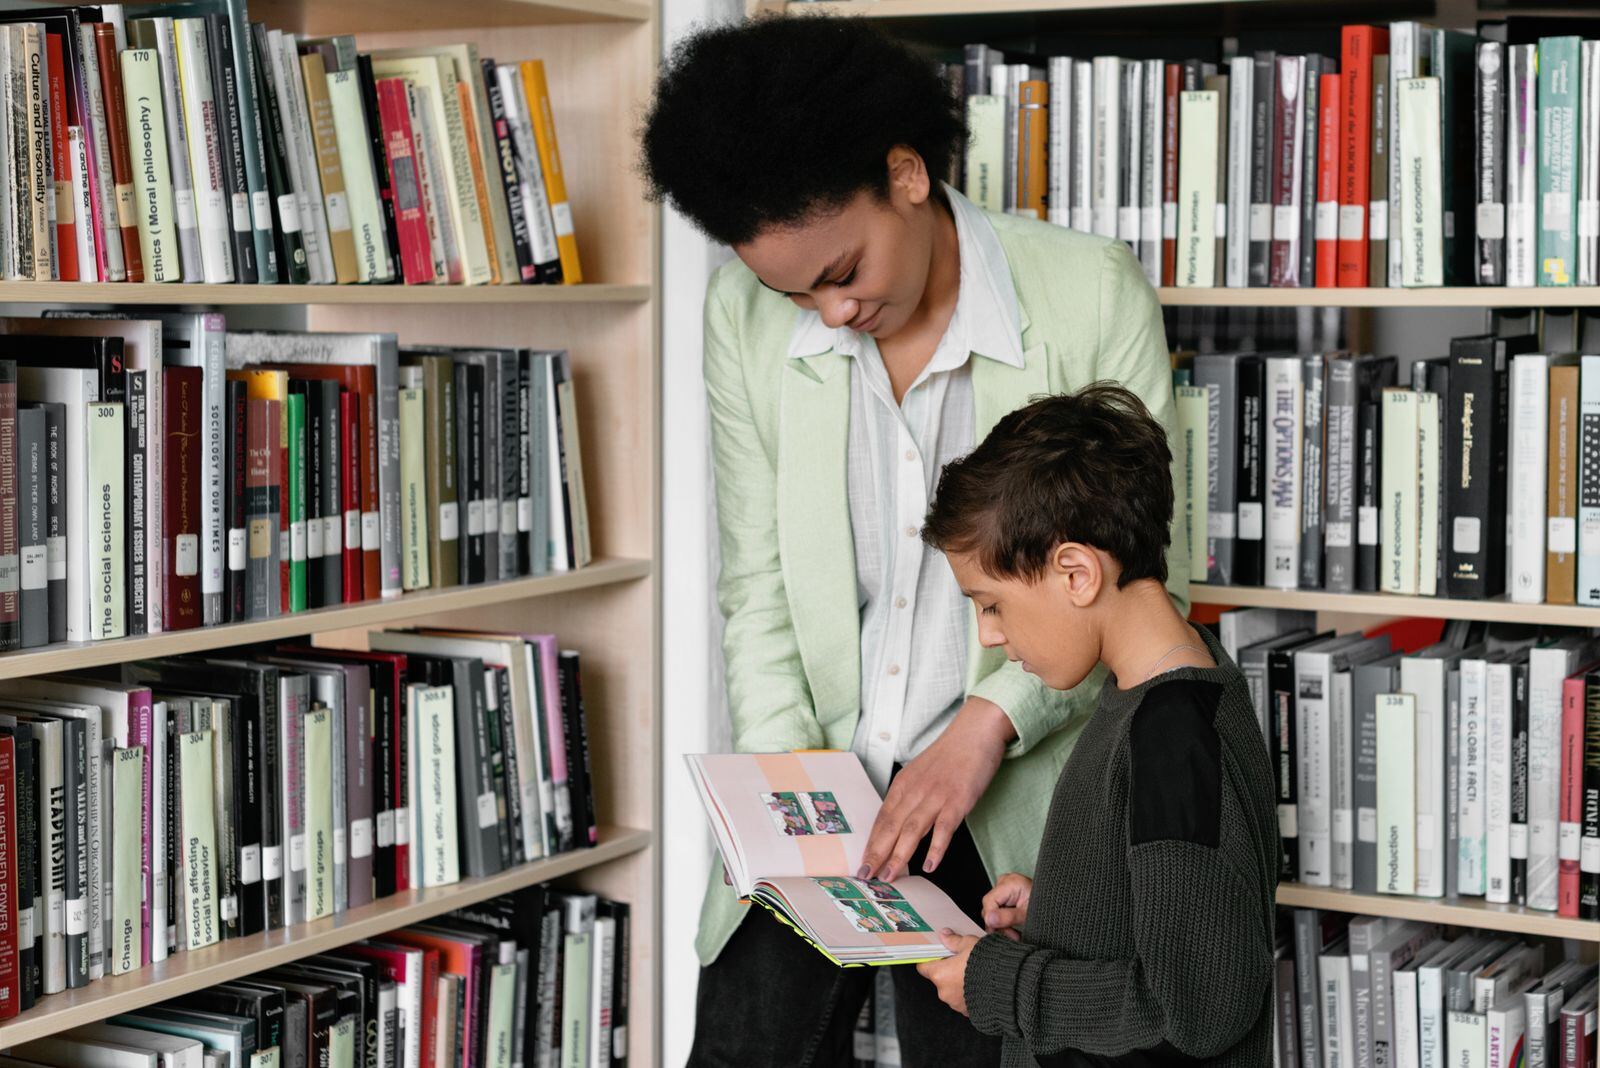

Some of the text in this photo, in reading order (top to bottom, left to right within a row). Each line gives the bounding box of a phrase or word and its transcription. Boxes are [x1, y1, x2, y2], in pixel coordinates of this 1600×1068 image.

[31, 53, 41, 101] Culture
[133, 52, 149, 62] 170
[1348, 69, 1357, 106] Theories
[1408, 81, 1426, 90] 332
[33, 103, 43, 127] and
[202, 100, 212, 134] PUBLIC
[224, 67, 242, 166] ETHICS FOR PUBLIC
[489, 85, 517, 184] TALK NOT
[1551, 106, 1562, 174] CORPORATE
[1562, 106, 1573, 171] FINANCIAL
[35, 130, 45, 204] Personality
[43, 131, 52, 176] ILLUSIONS
[80, 152, 88, 171] and
[81, 174, 89, 189] the
[454, 134, 479, 223] COMMENTARY
[1348, 136, 1356, 173] LABOR
[83, 191, 91, 208] Box
[140, 106, 163, 282] Ethics Moral philosophy
[1415, 157, 1424, 283] Financial economics
[362, 223, 376, 280] Religion
[1188, 235, 1199, 285] Working
[98, 407, 114, 418] 300
[1273, 389, 1295, 479] THE OPTIONS
[1461, 393, 1474, 488] Ecological Economics
[0, 418, 15, 494] Reimagining
[50, 426, 58, 504] THE BOOK OF ANSWERS
[210, 340, 220, 553] KENDALL SOCIOLOGY IN OUR TIMES
[31, 475, 38, 483] IN
[102, 484, 113, 637] The social sciences
[133, 454, 145, 615] CONTEMPORARY ISSUES IN SOCIETY
[1392, 491, 1403, 589] Land economics
[411, 550, 420, 587] Social
[431, 714, 443, 754] groups
[1467, 696, 1478, 716] THE
[120, 749, 140, 762] 303.4
[190, 734, 204, 744] 304
[1467, 721, 1478, 767] GLOBAL
[167, 753, 175, 862] technology society
[435, 760, 443, 804] national
[50, 785, 64, 893] LEADERSHIP
[77, 782, 87, 884] VALUES and PUBLIC
[90, 755, 101, 930] LEADERSHIP IN ORGANIZATIONS
[1388, 825, 1399, 891] Production
[18, 841, 27, 890] CENTURY
[190, 837, 201, 946] Factors affecting
[202, 845, 212, 942] social behavior
[316, 829, 325, 916] Social groups
[0, 875, 9, 931] POWER
[122, 919, 131, 971] Change
[1327, 980, 1337, 993] THE
[260, 1054, 272, 1065] 307
